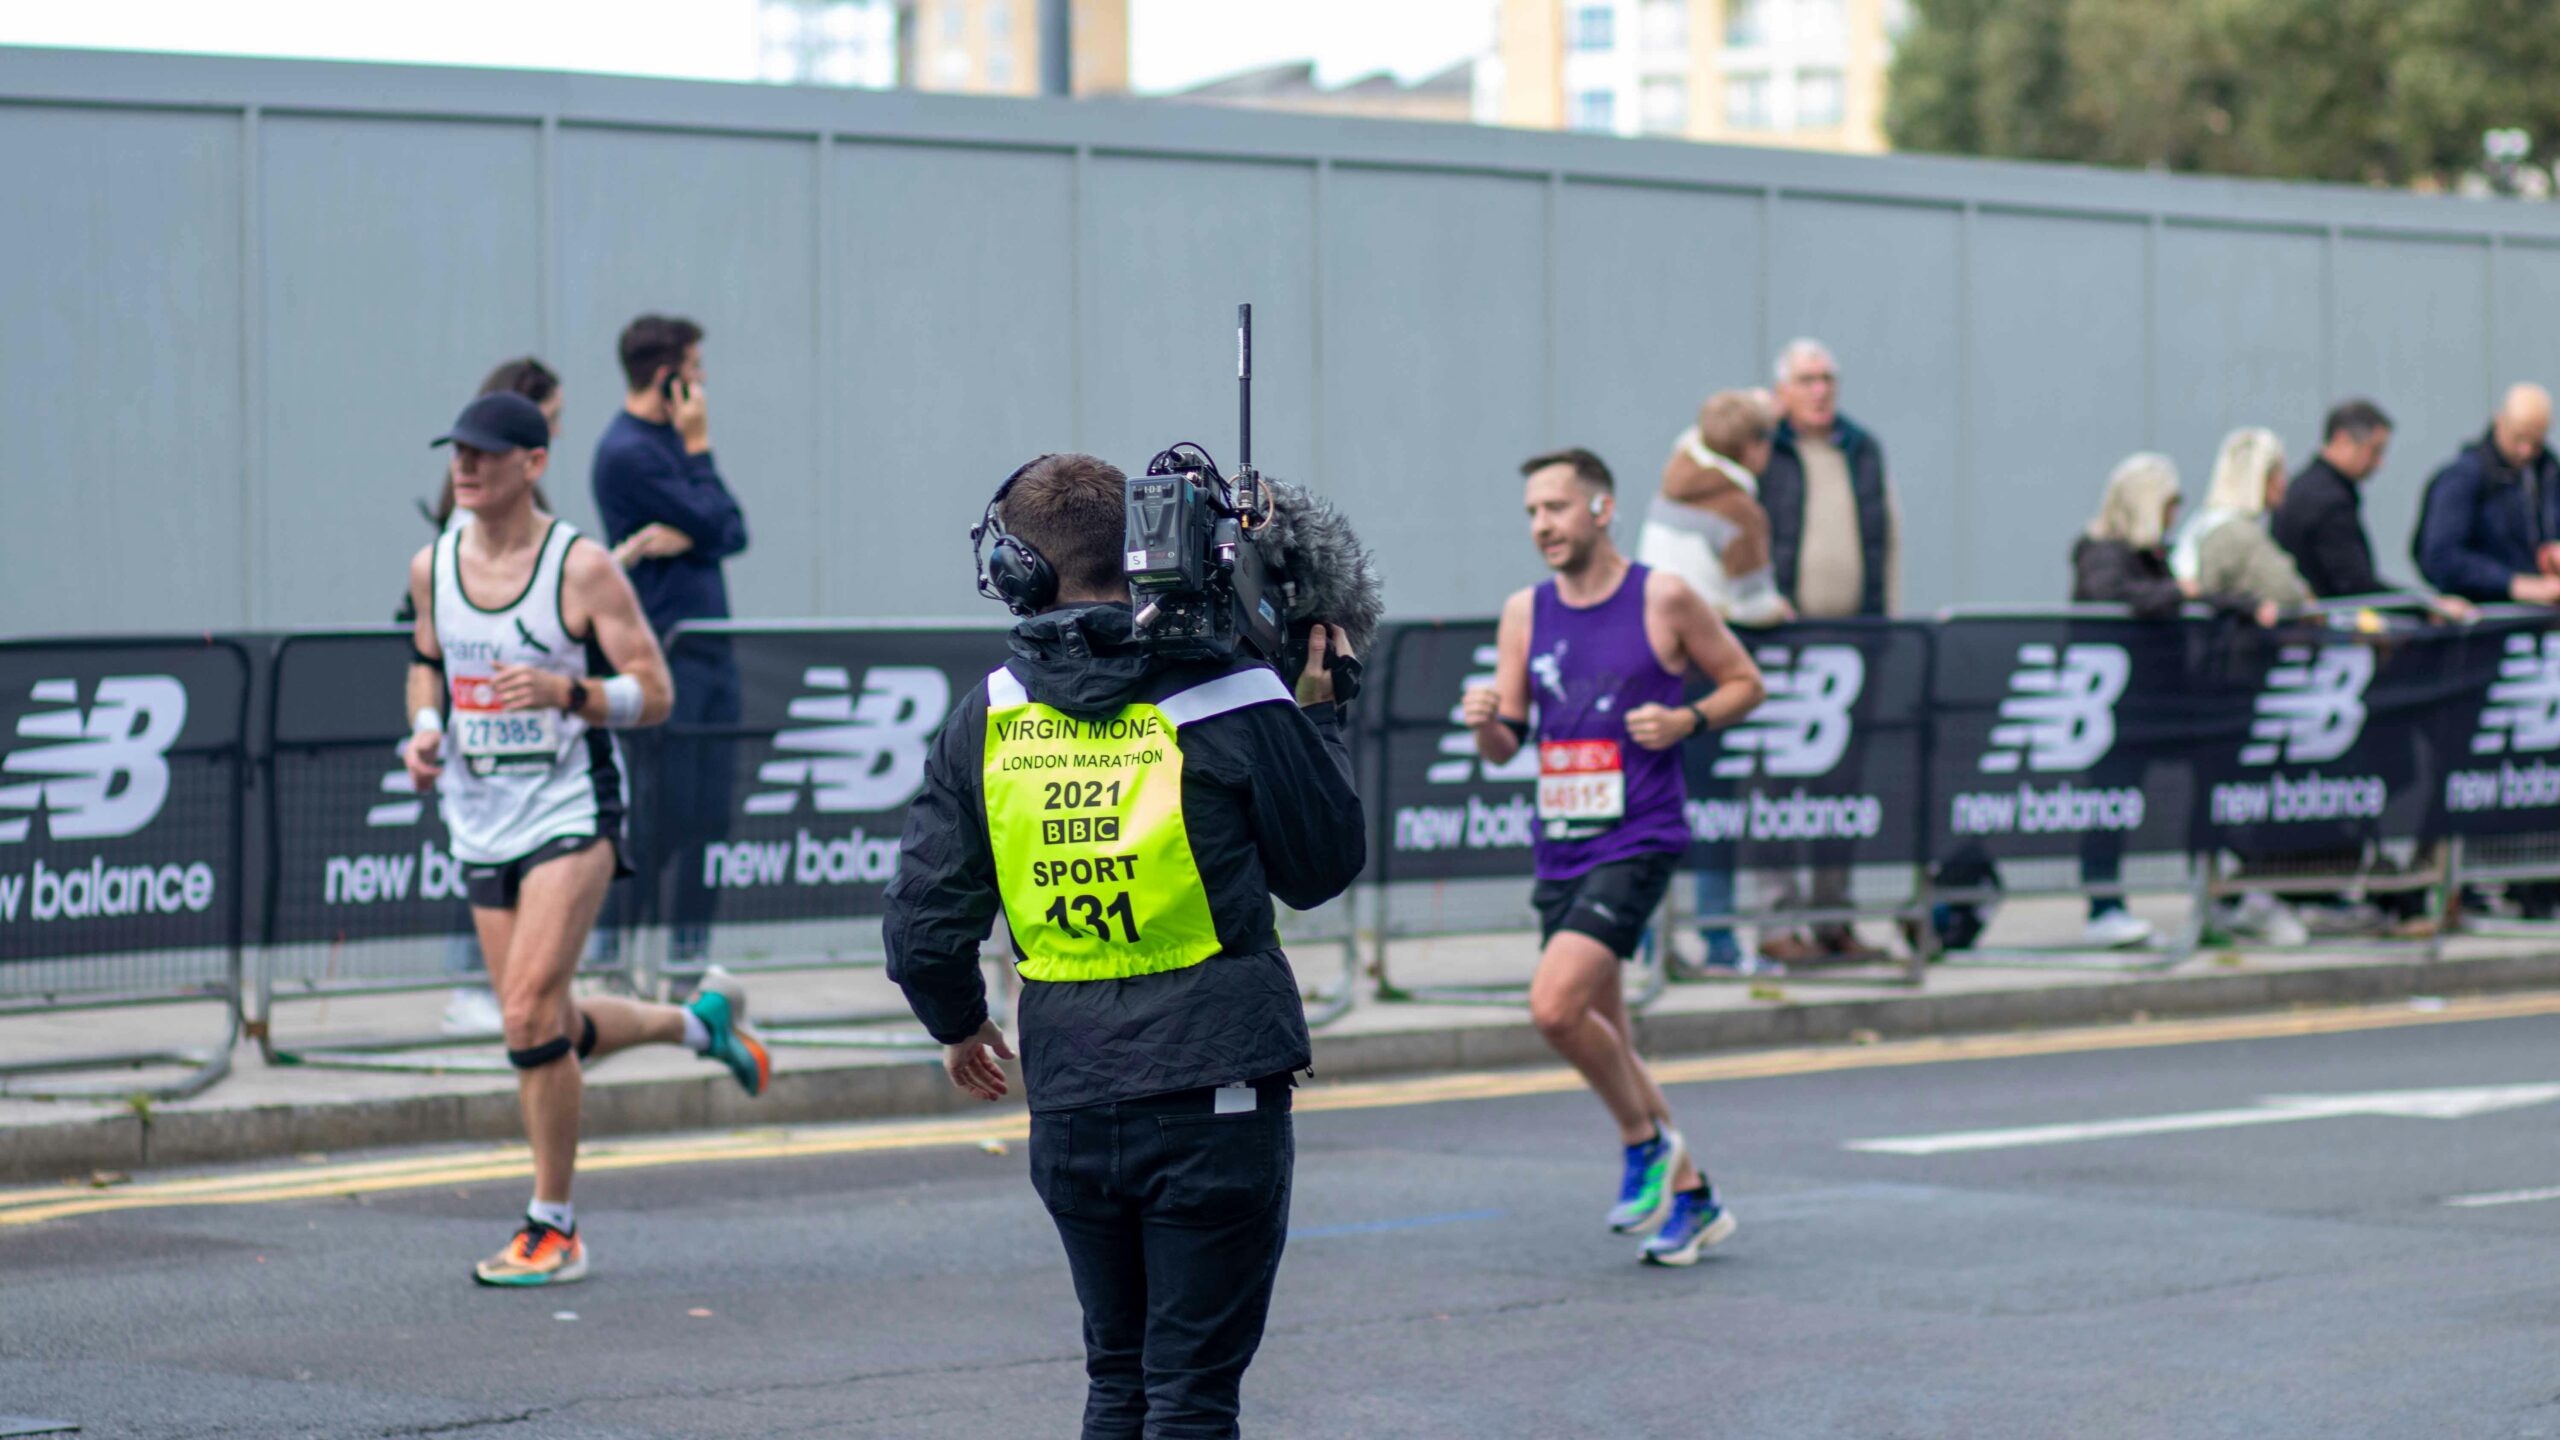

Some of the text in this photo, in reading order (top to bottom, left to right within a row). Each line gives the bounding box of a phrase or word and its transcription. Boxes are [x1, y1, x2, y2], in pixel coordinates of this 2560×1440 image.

[465, 718, 544, 746] 27385
[996, 716, 1167, 742] VIRGIN MONE
[1002, 749, 1163, 771] LONDON MARATHON
[1044, 780, 1121, 810] 2021
[1751, 788, 1884, 840] balance
[1952, 782, 2146, 834] new balance
[2212, 771, 2387, 824] new balance
[1043, 817, 1119, 845] BBC
[1395, 806, 1464, 849] new
[325, 854, 415, 904] new
[704, 840, 791, 887] new
[1033, 854, 1138, 887] SPORT
[31, 855, 215, 922] balance
[1045, 891, 1141, 944] 131
